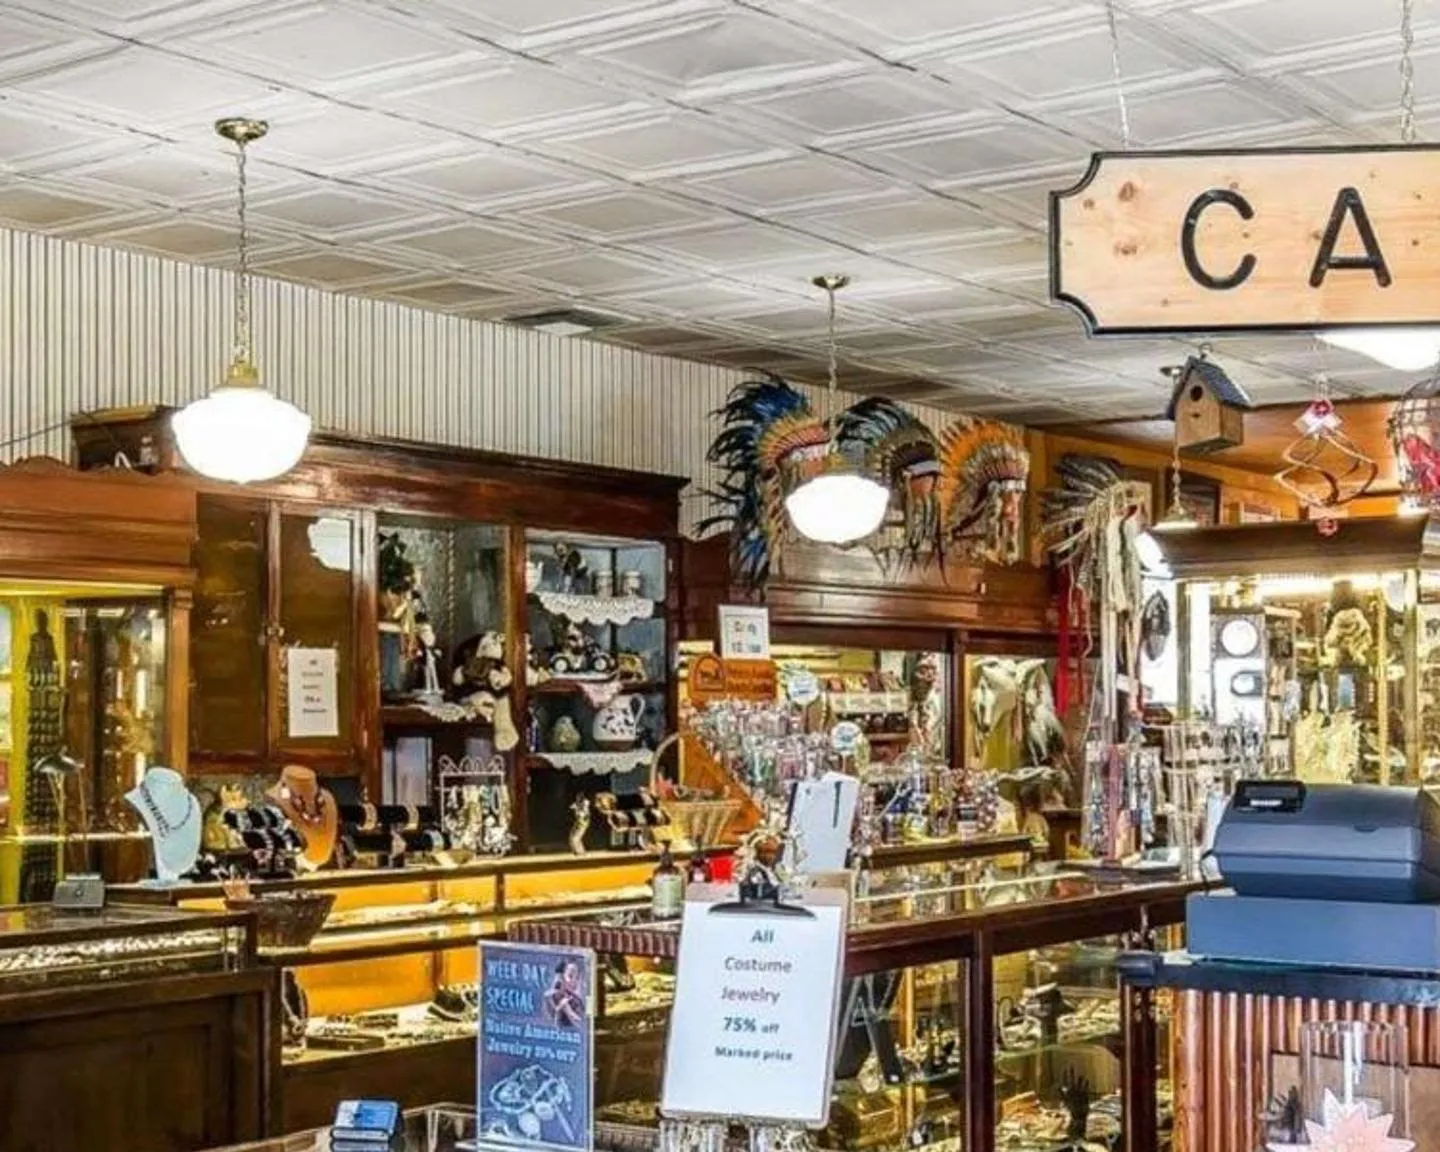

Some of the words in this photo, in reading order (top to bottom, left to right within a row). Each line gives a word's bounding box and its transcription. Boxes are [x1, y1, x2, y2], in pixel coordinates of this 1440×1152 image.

[750, 929, 775, 943] All
[724, 955, 793, 973] Costume
[486, 986, 535, 1014] SPECIAL
[721, 986, 781, 1005] Jewelry
[523, 1023, 582, 1044] American
[723, 1016, 757, 1032] 75%
[761, 1022, 781, 1034] off
[715, 1046, 760, 1059] Marked
[763, 1049, 793, 1061] price
